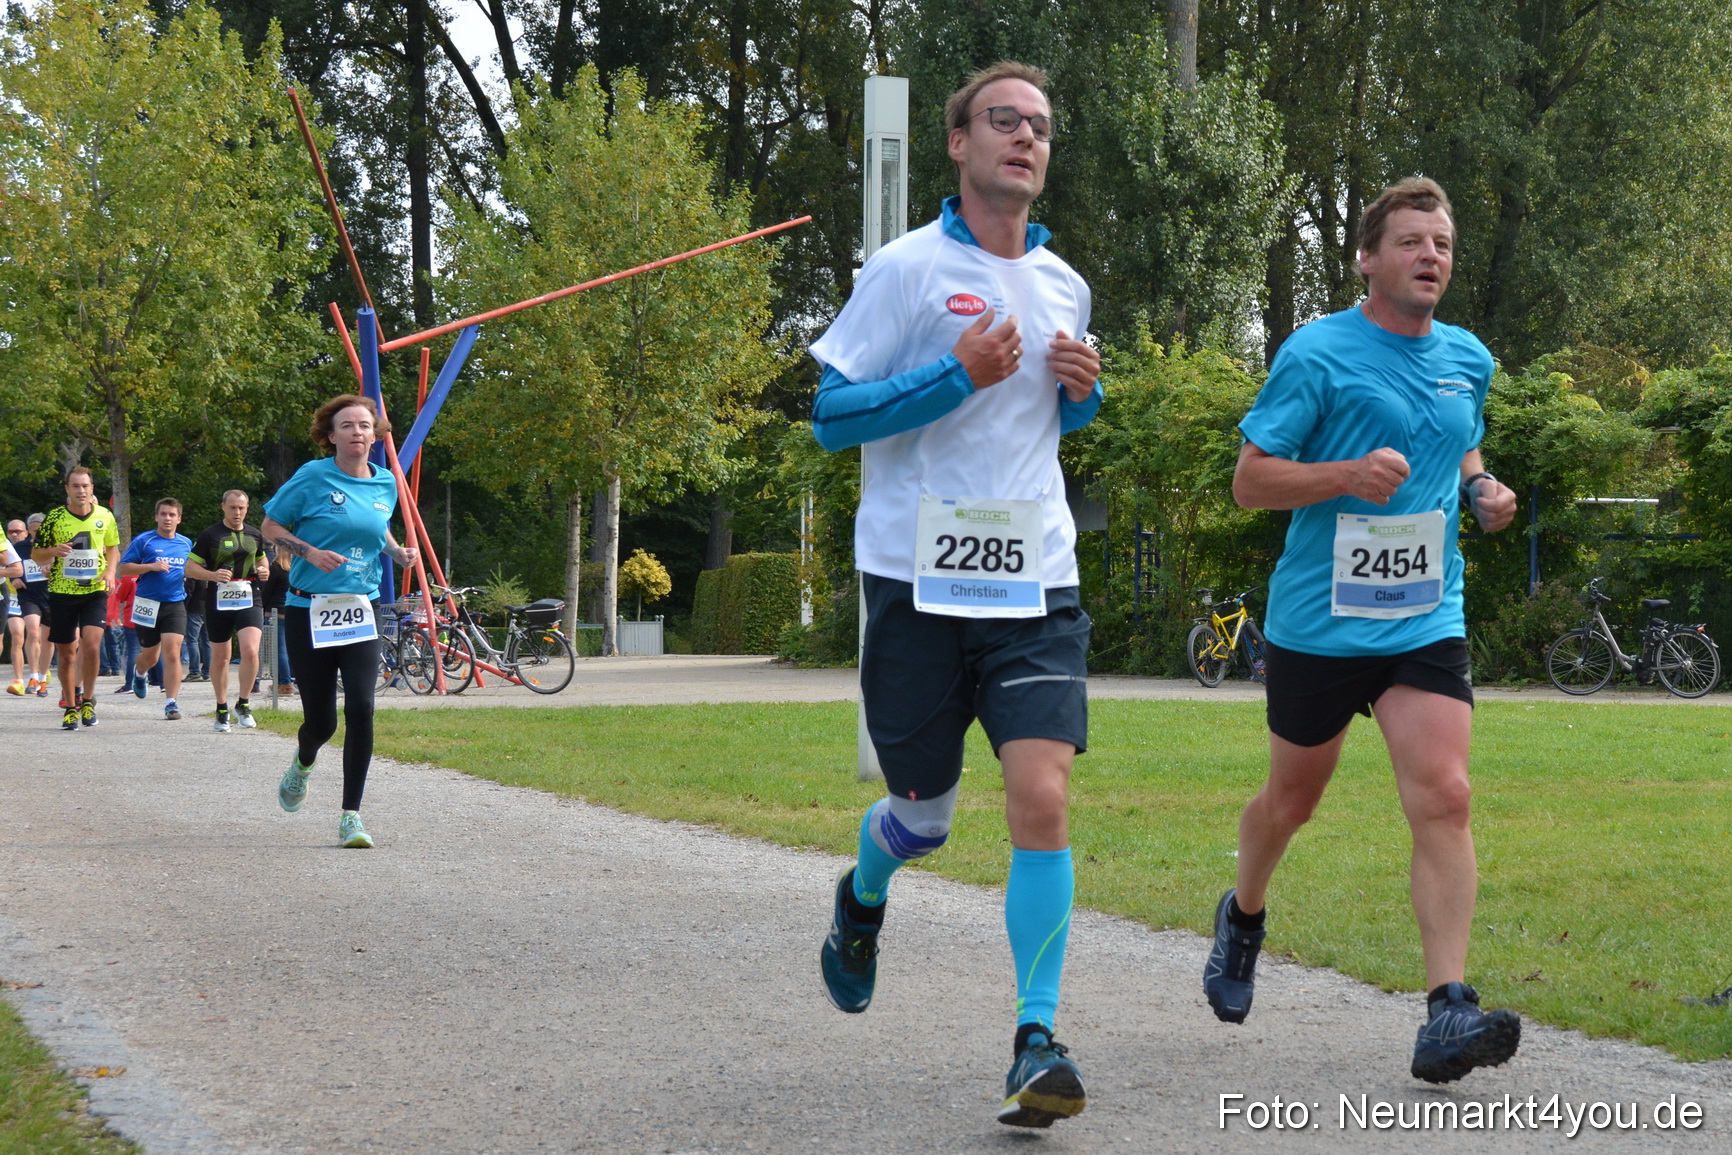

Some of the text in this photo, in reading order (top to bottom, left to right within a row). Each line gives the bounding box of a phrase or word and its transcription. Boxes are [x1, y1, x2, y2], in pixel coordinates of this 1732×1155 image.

[967, 509, 1011, 521] BOCK
[1379, 524, 1416, 535] BOCK
[934, 534, 1024, 573] 2285
[69, 558, 94, 568] 2690
[1351, 544, 1428, 579] 2454
[222, 590, 247, 599] 2254
[951, 583, 1008, 599] Christian
[1375, 590, 1406, 602] Claus
[134, 604, 154, 617] 2296
[319, 607, 365, 627] 2249
[333, 630, 356, 638] Andrea
